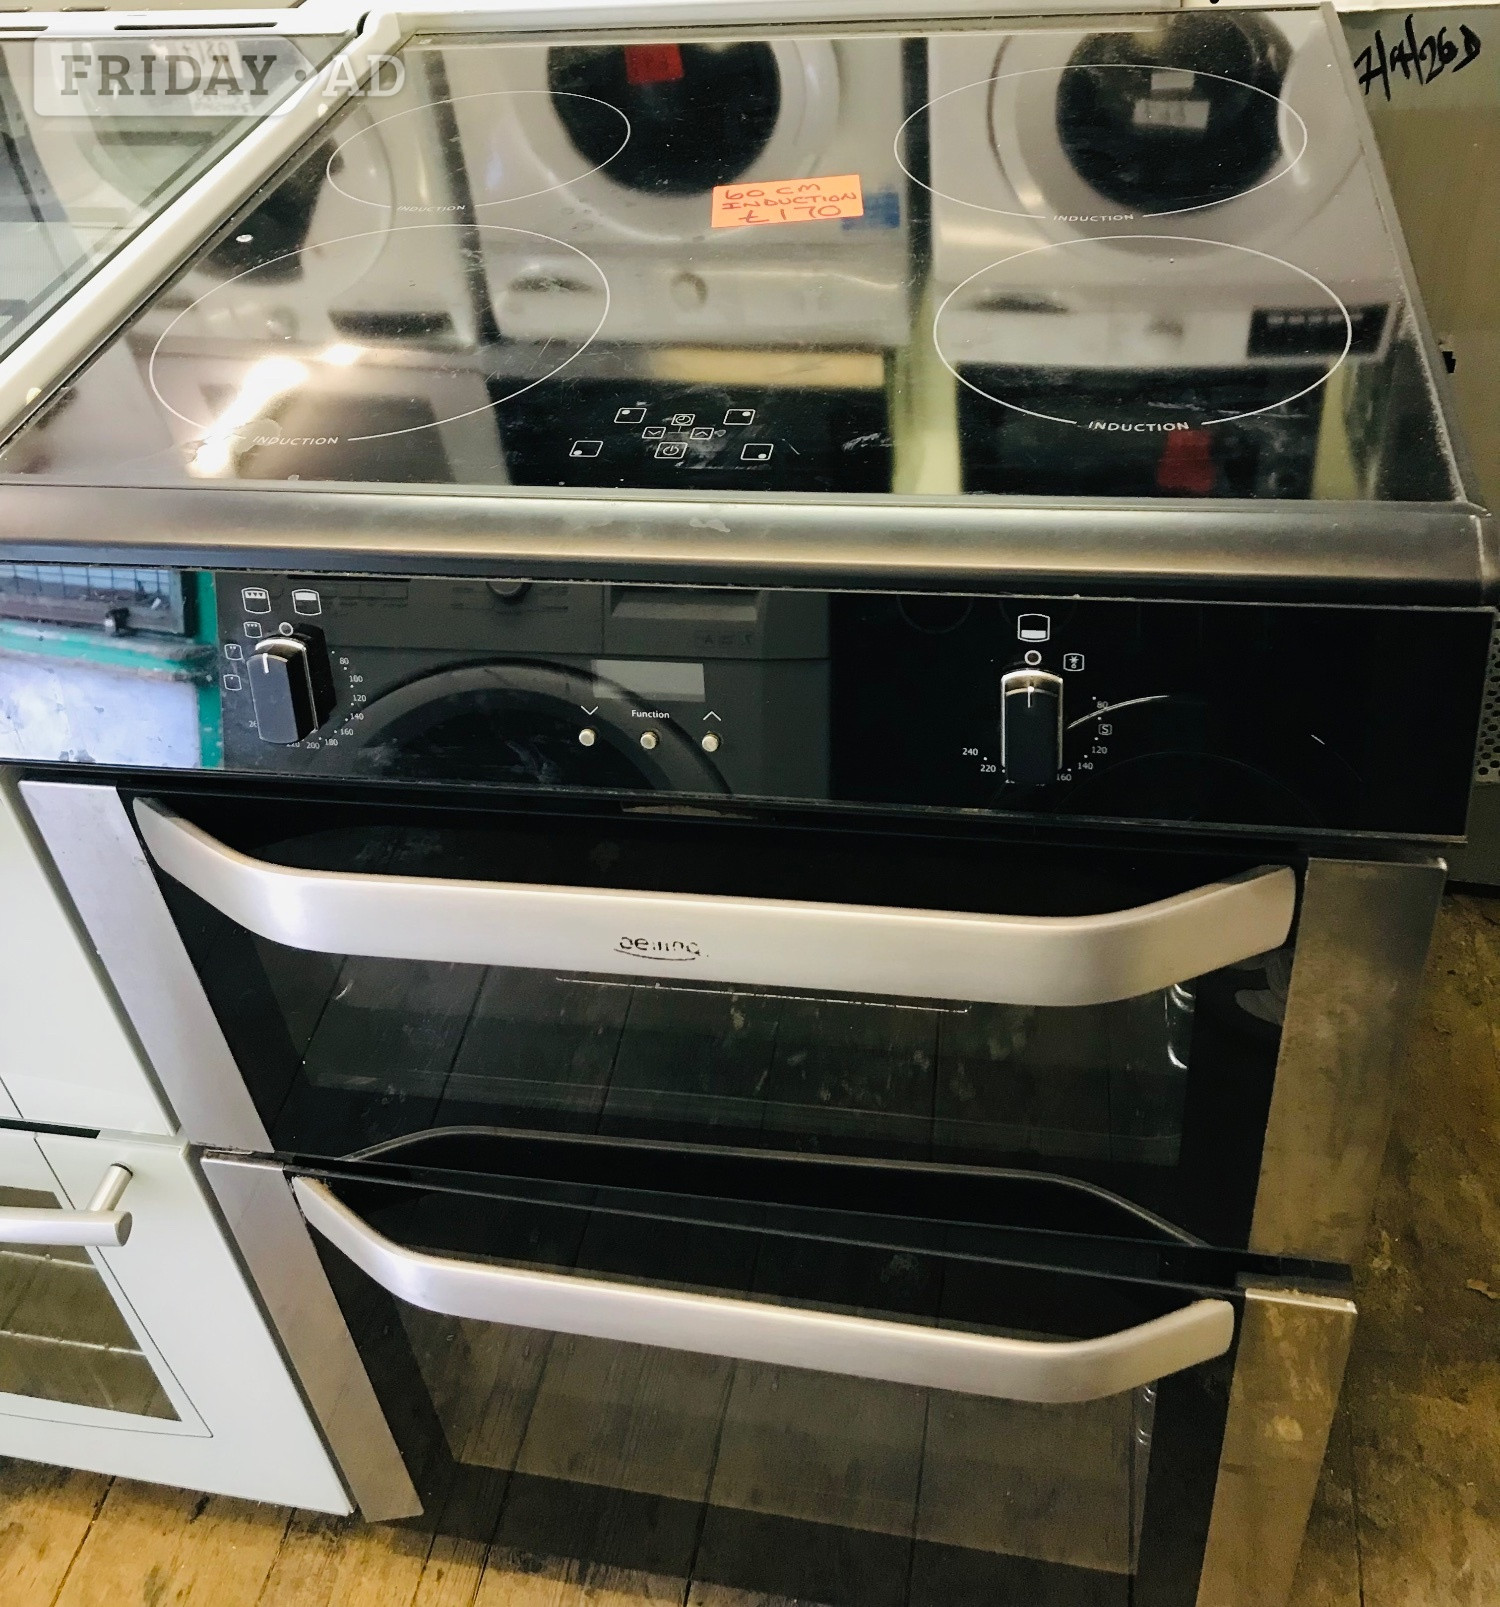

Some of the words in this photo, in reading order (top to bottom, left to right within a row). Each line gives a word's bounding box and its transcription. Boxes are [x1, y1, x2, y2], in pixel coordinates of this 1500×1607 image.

[725, 188, 765, 200] 60
[776, 183, 821, 195] CM
[722, 192, 857, 210] INDUCTION
[396, 204, 467, 212] INDUCTION
[1053, 213, 1134, 222] INDUCTION
[1088, 420, 1190, 432] INDUCTION
[252, 435, 339, 446] INDUCTION
[339, 657, 350, 665] 80
[349, 675, 364, 683] 100
[352, 694, 367, 702] 120
[1096, 701, 1109, 709] 80
[350, 712, 365, 720] 140
[631, 709, 670, 719] Function
[340, 728, 354, 736] 160
[306, 741, 321, 749] 200
[324, 738, 339, 746] 180
[962, 747, 979, 756] 240
[1091, 746, 1108, 754] 120
[980, 764, 997, 773] 220
[1078, 762, 1094, 770] 140
[1056, 773, 1072, 781] 160
